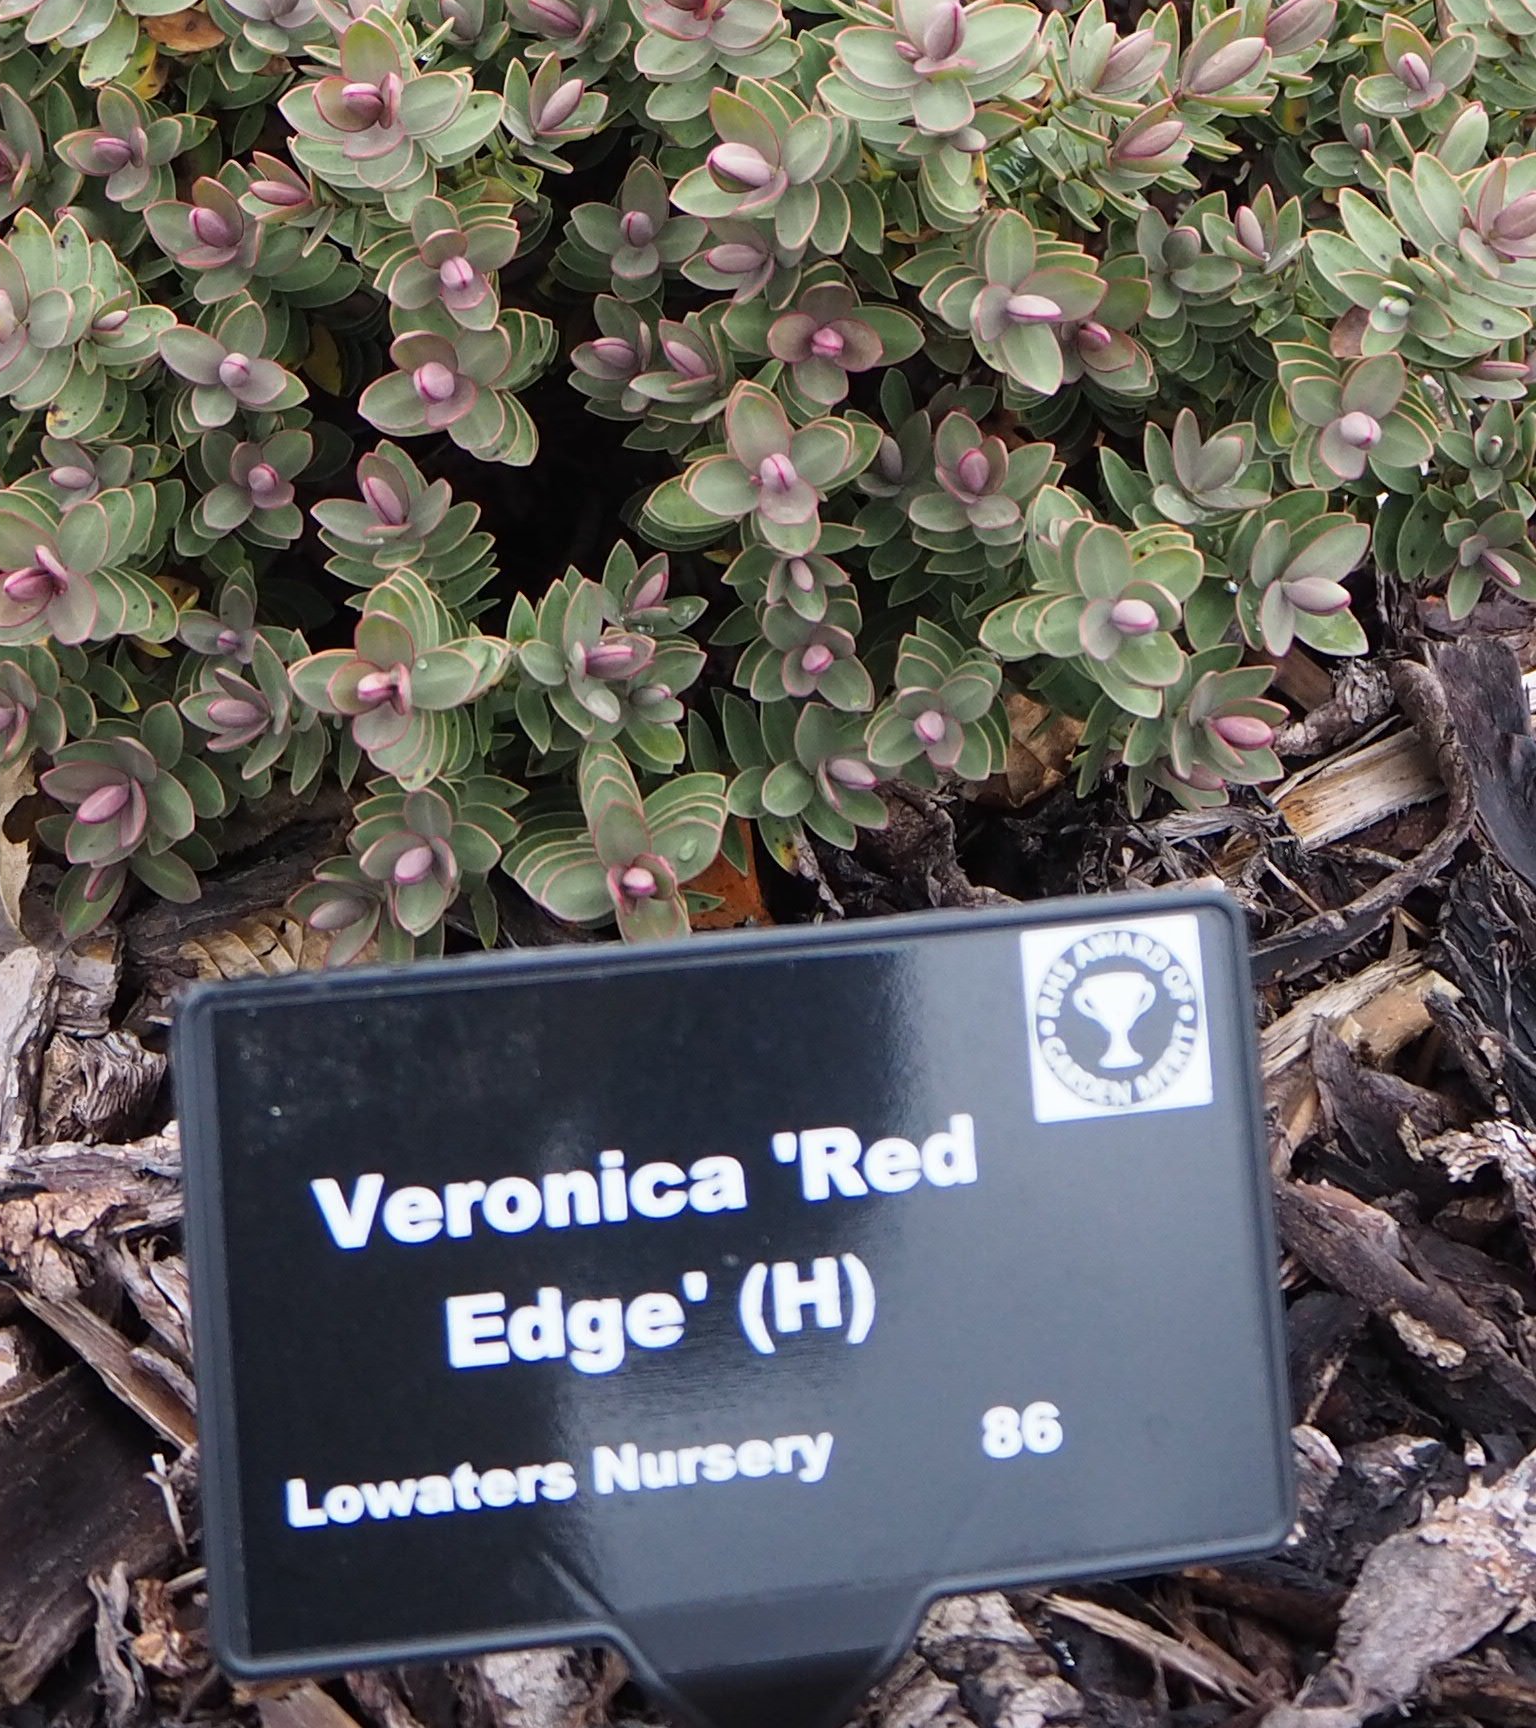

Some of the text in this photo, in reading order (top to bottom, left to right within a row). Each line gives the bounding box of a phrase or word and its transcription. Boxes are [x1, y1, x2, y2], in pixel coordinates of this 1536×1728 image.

[1037, 931, 1195, 1018] RHS AWARD OF
[1041, 1021, 1196, 1106] GARDEN MERIT
[312, 1112, 978, 1249] Veronica 'Red
[446, 1253, 876, 1374] Edge' (H)
[982, 1401, 1063, 1459] 86
[287, 1432, 834, 1527] Lowaters Nursery
